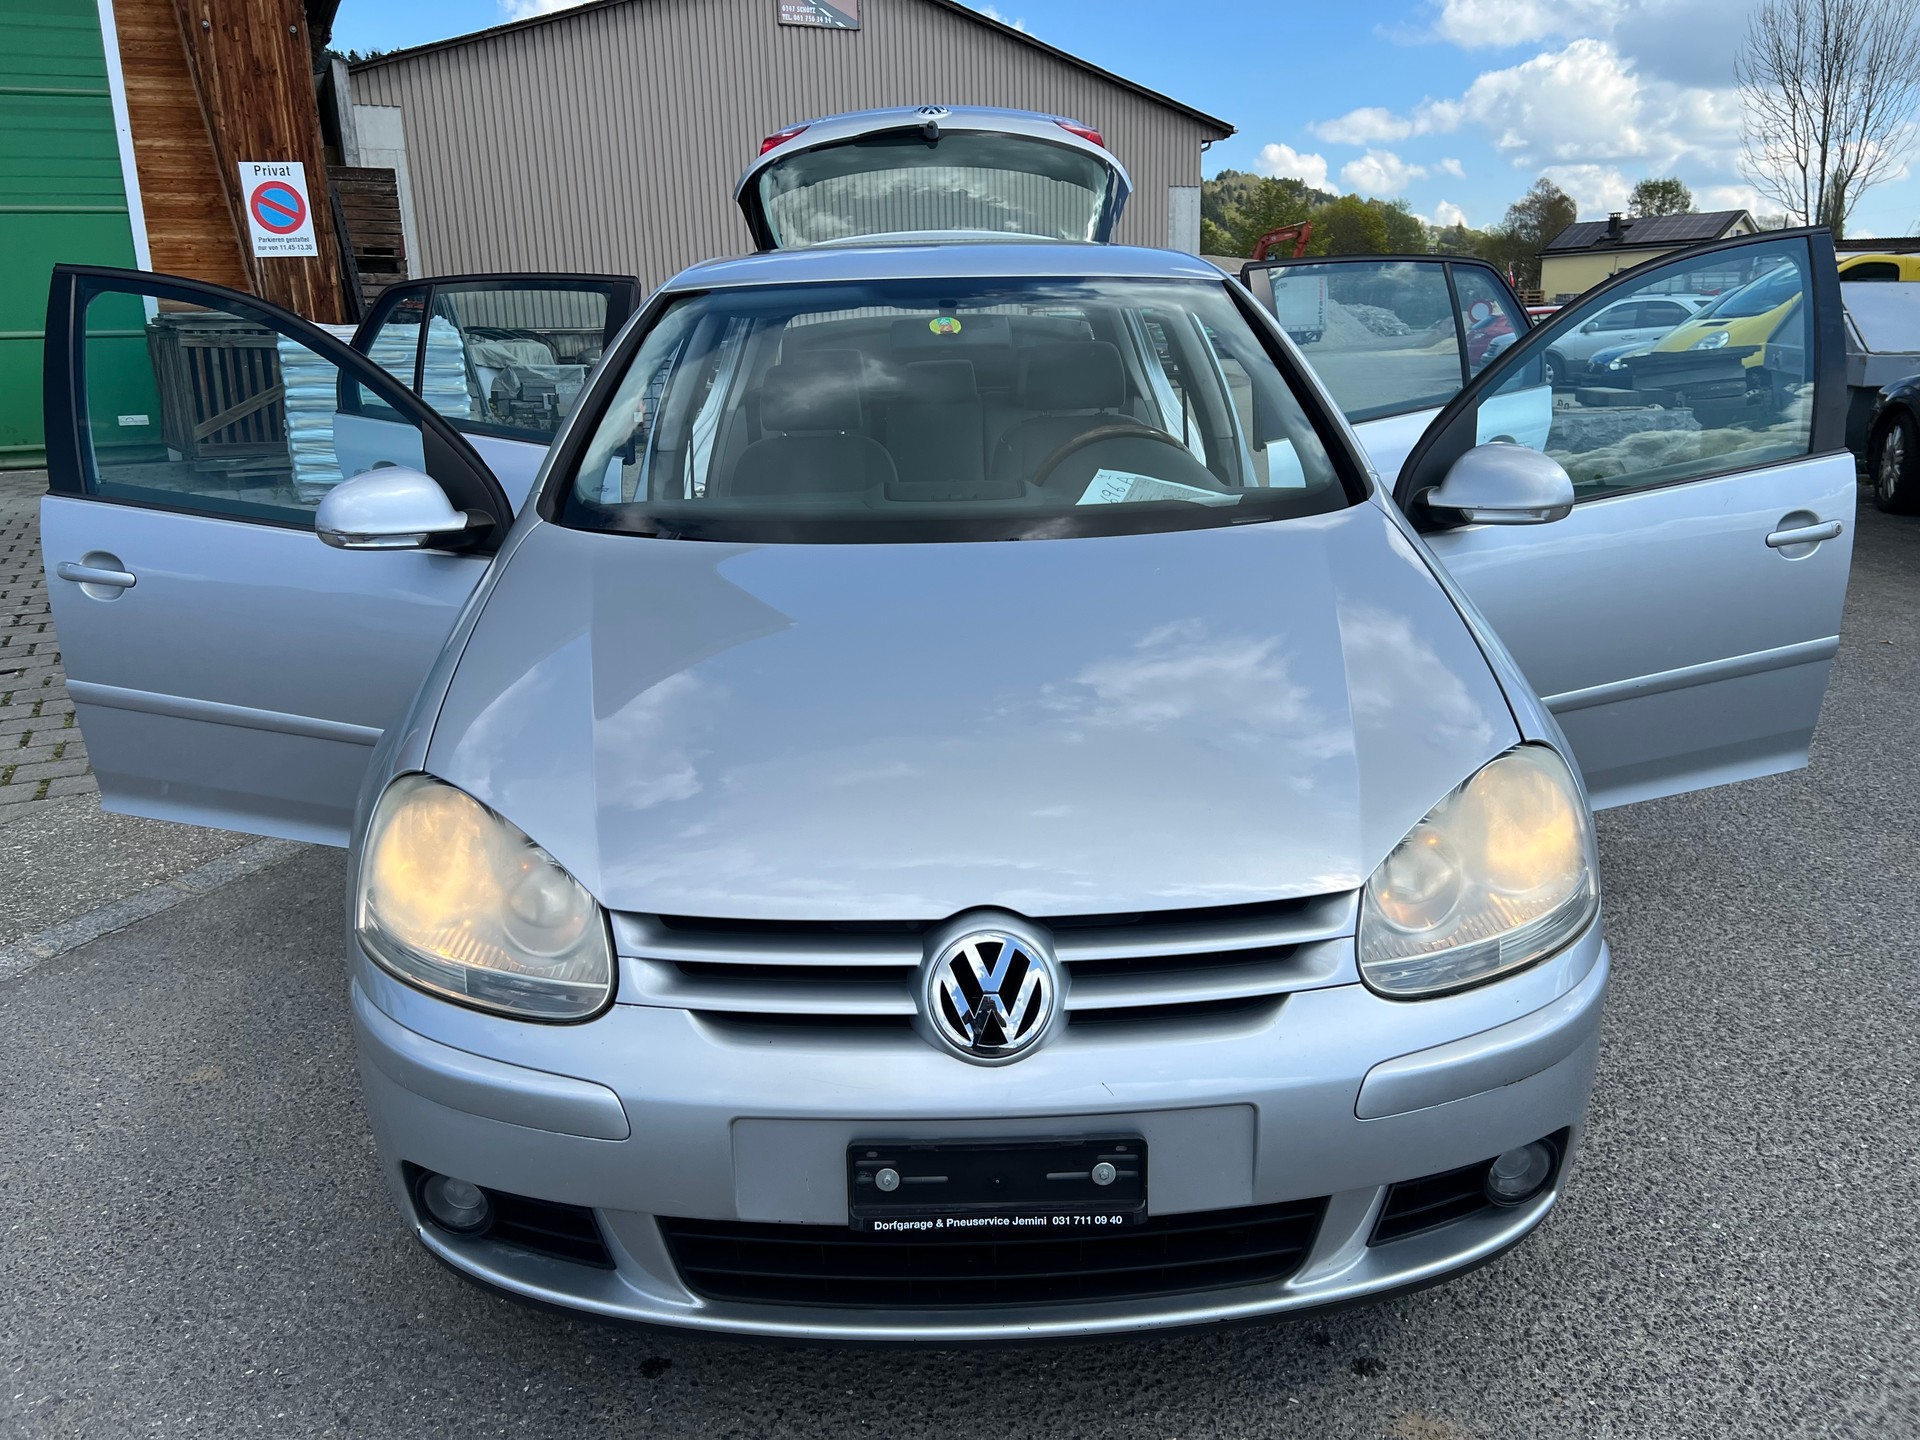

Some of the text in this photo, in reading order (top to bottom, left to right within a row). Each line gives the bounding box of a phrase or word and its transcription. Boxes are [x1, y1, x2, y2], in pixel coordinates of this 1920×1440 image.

[254, 165, 291, 177] Privat
[286, 236, 310, 244] gestattet
[874, 1215, 1123, 1231] Dorfgarage & Pneuservice Jemini 031 711 09 40
